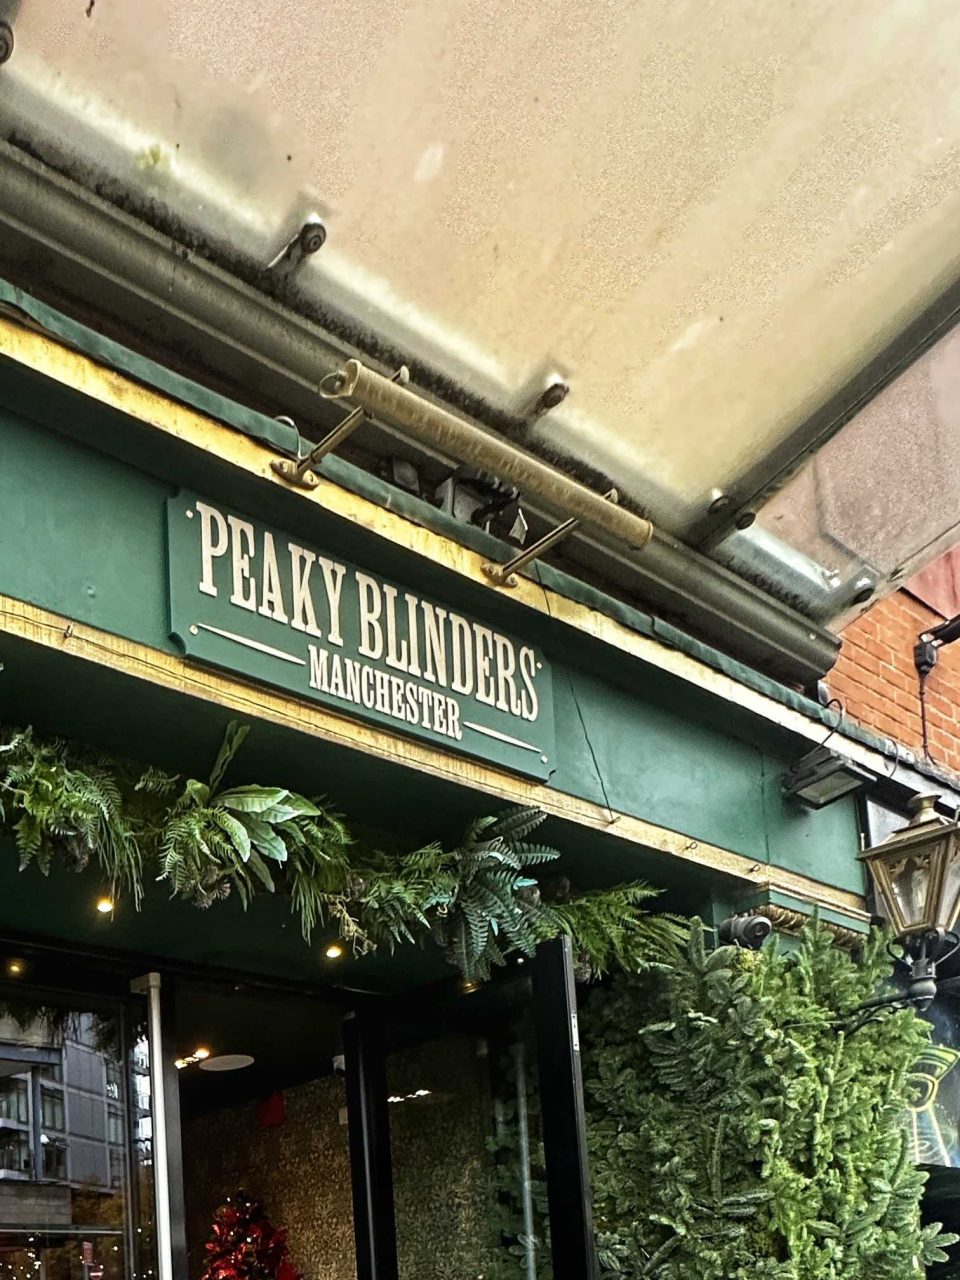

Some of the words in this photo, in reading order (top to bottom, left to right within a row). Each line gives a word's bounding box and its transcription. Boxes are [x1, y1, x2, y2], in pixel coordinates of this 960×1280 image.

[195, 501, 346, 647] PEAKY
[356, 574, 535, 722] BLINDERS
[308, 644, 463, 741] MANCHESTER
